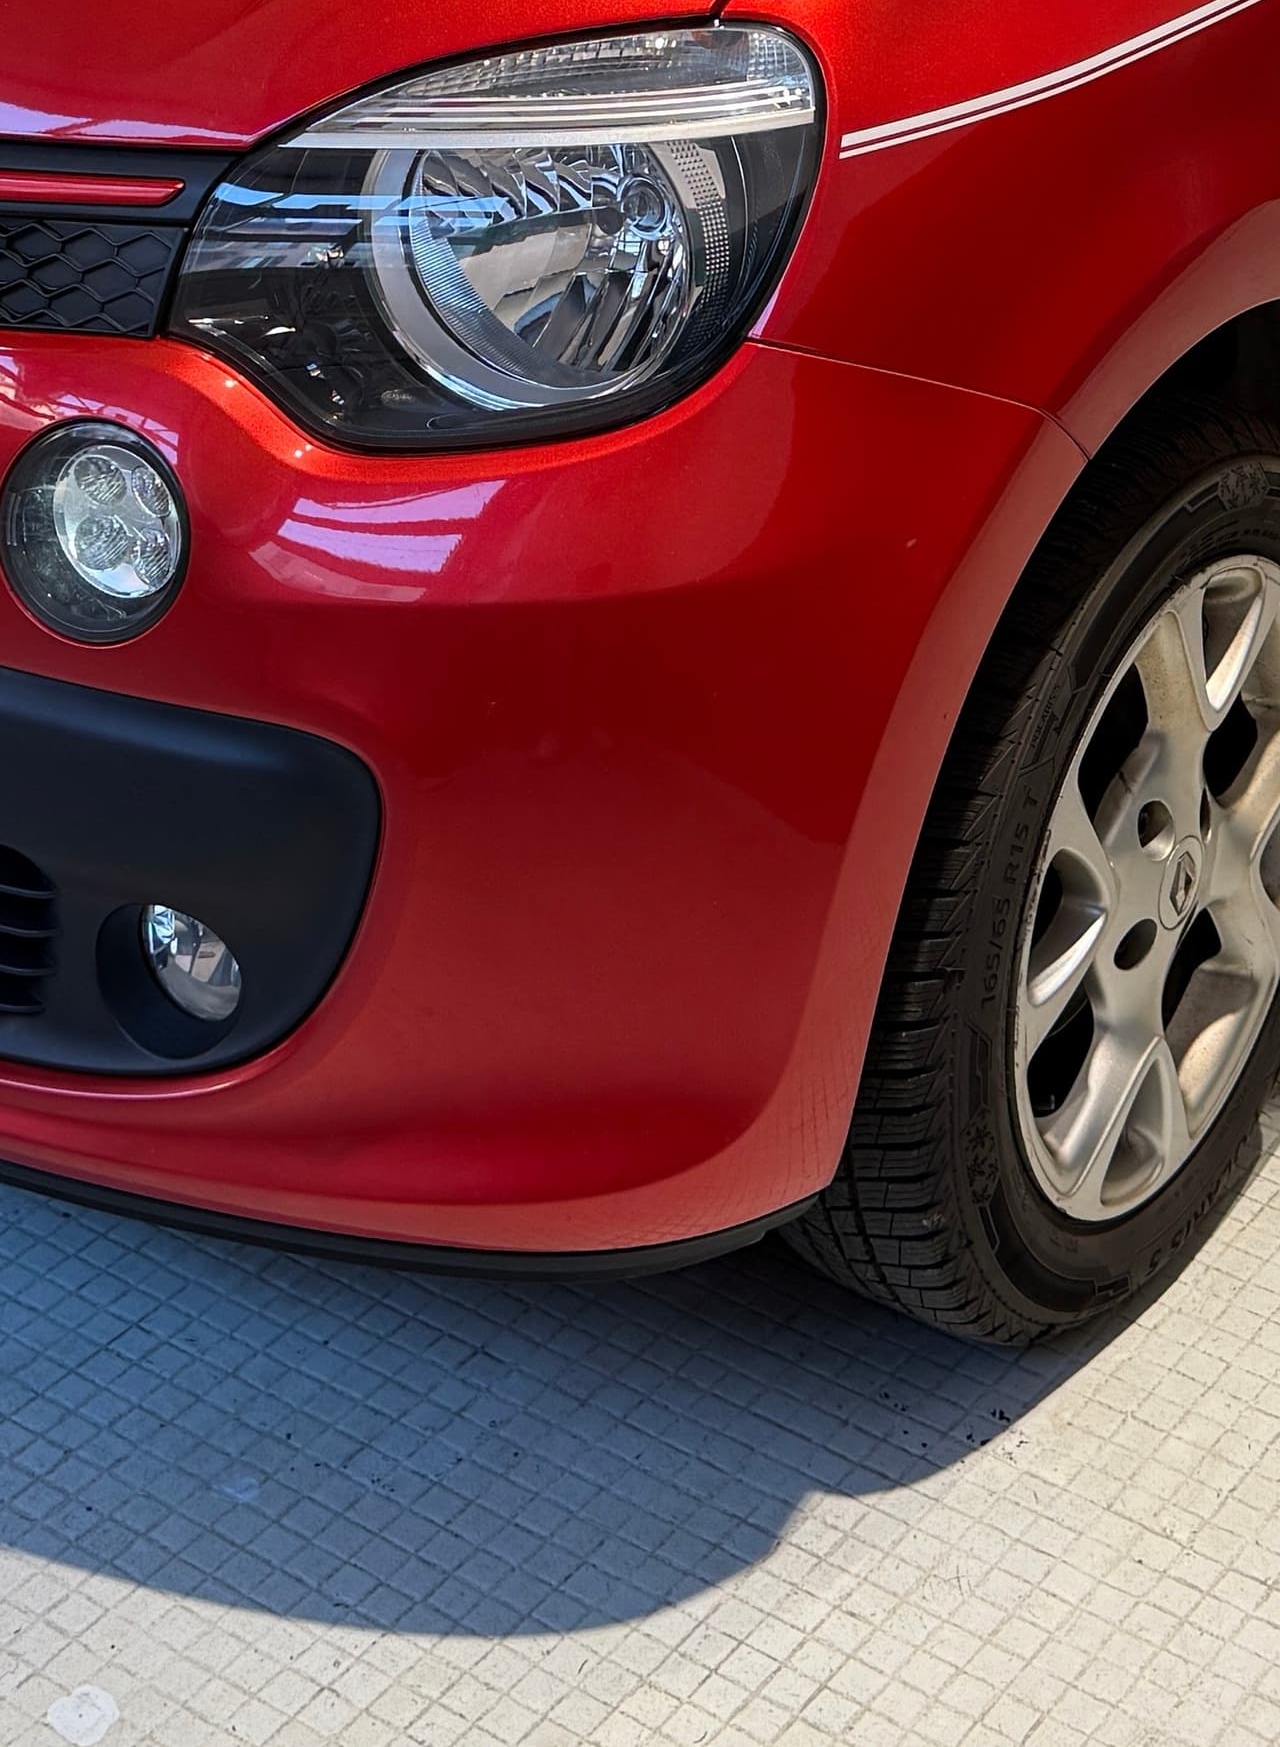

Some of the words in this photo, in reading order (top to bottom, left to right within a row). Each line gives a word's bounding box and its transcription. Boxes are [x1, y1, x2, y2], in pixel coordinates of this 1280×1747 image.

[981, 896, 1011, 1009] 165/65
[1005, 823, 1029, 885] R15
[1023, 786, 1039, 809] T
